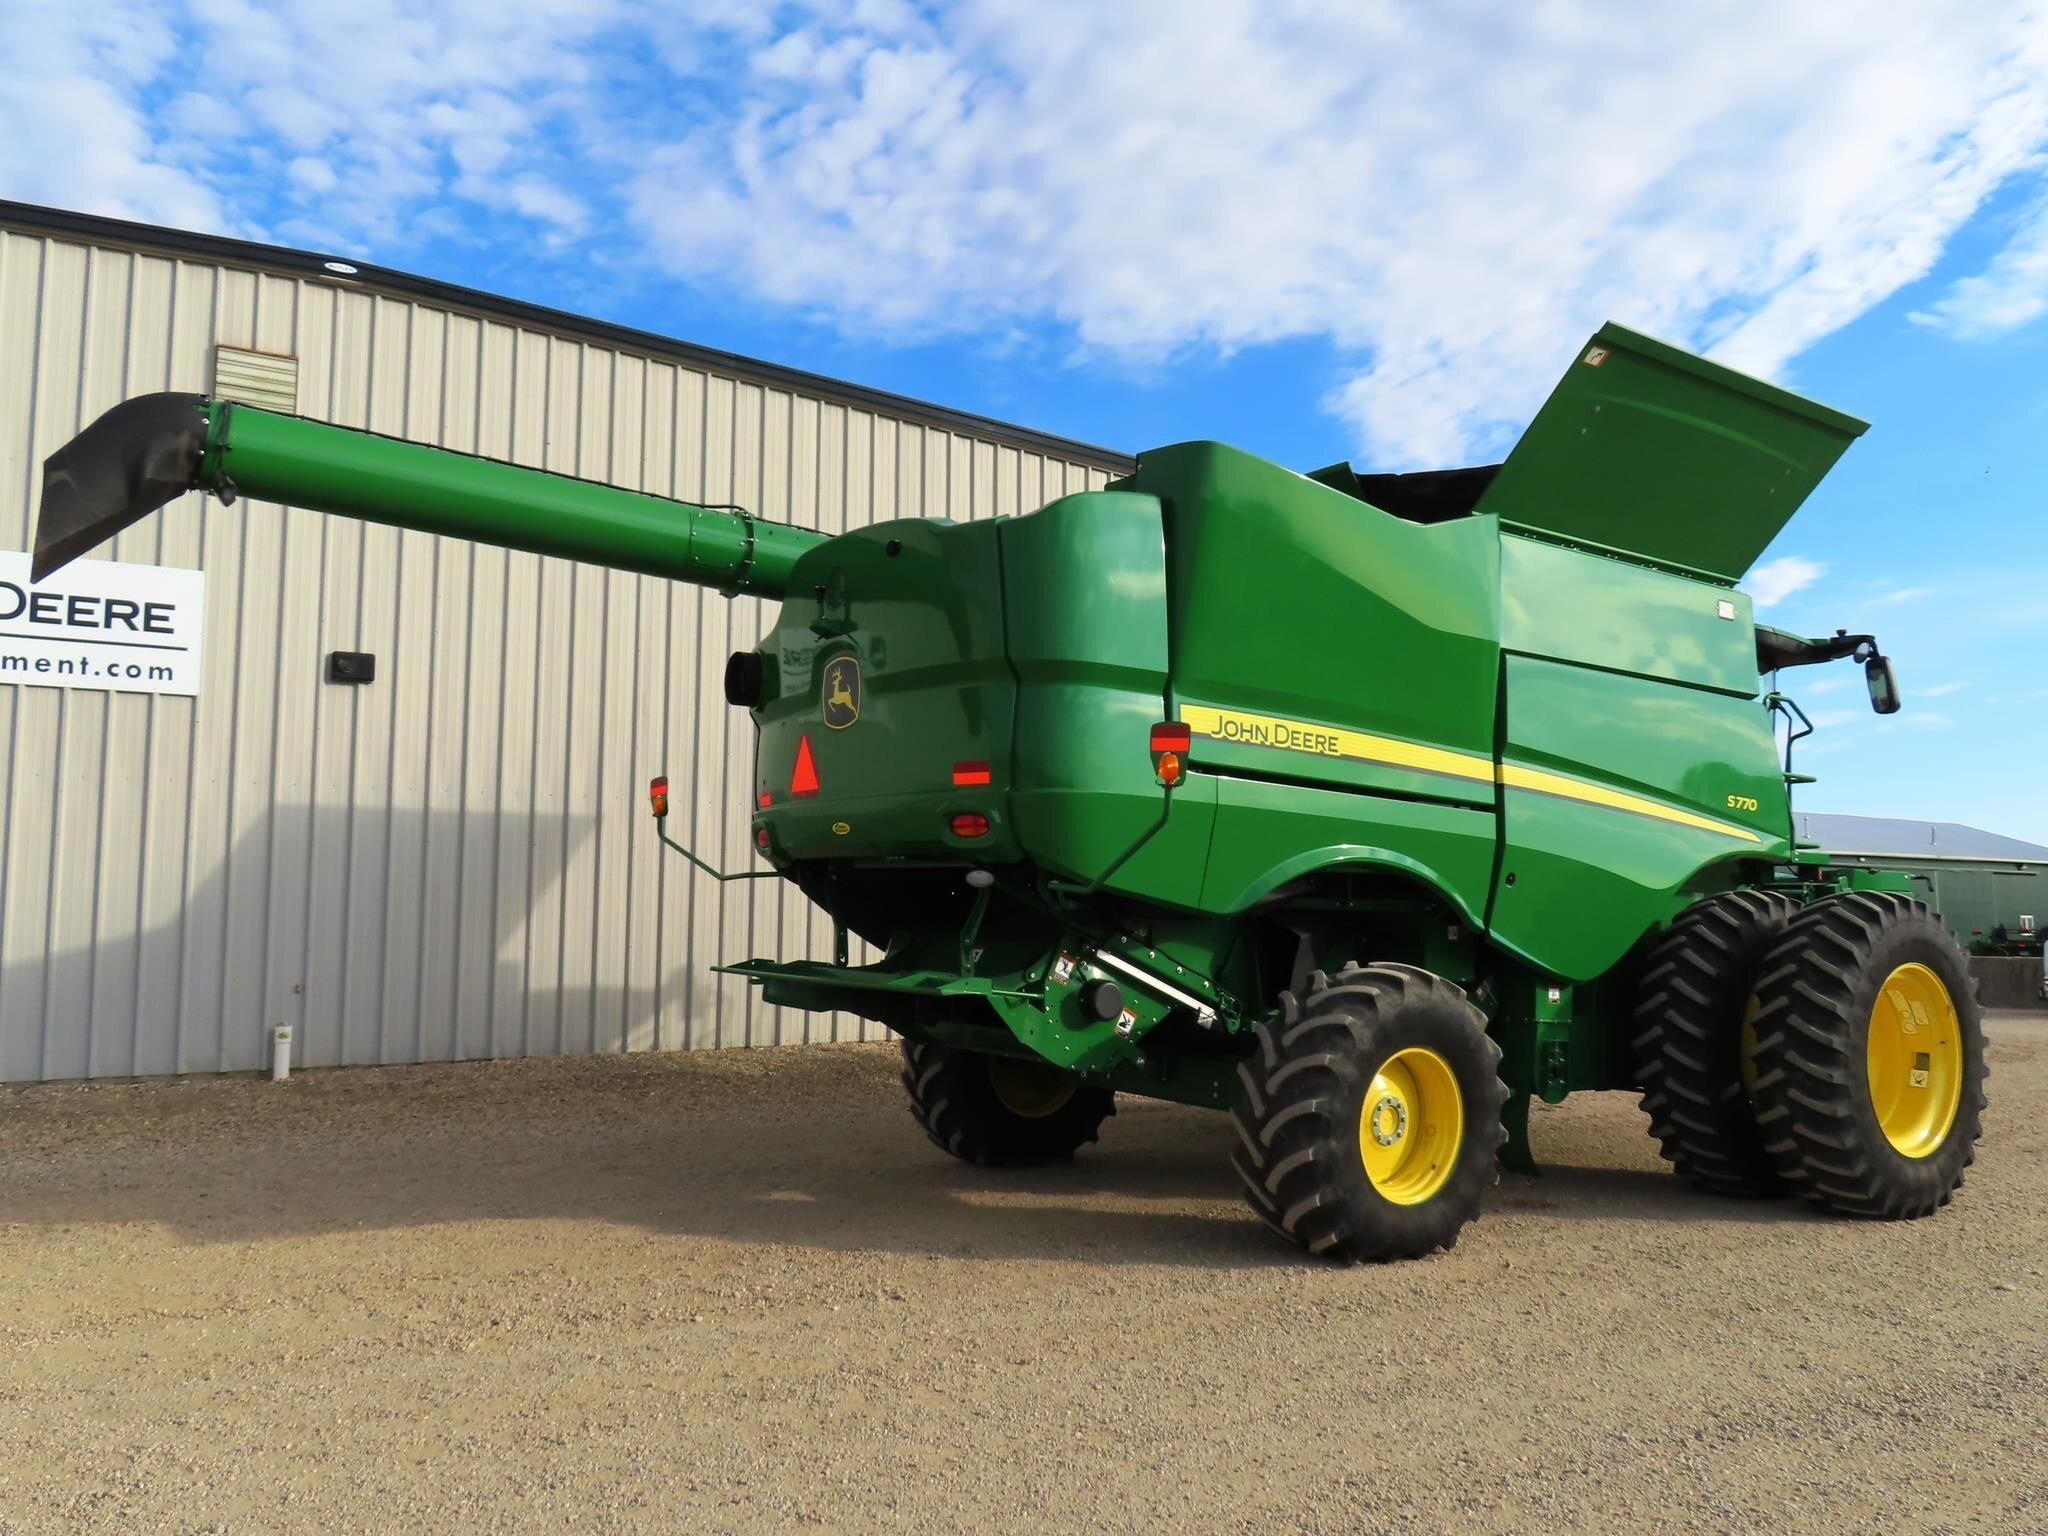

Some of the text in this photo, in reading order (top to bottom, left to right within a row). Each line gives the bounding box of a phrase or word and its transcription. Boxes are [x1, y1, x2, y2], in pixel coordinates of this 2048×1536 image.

[1212, 715, 1339, 753] JOHN DEERE
[1727, 795, 1757, 811] S770
